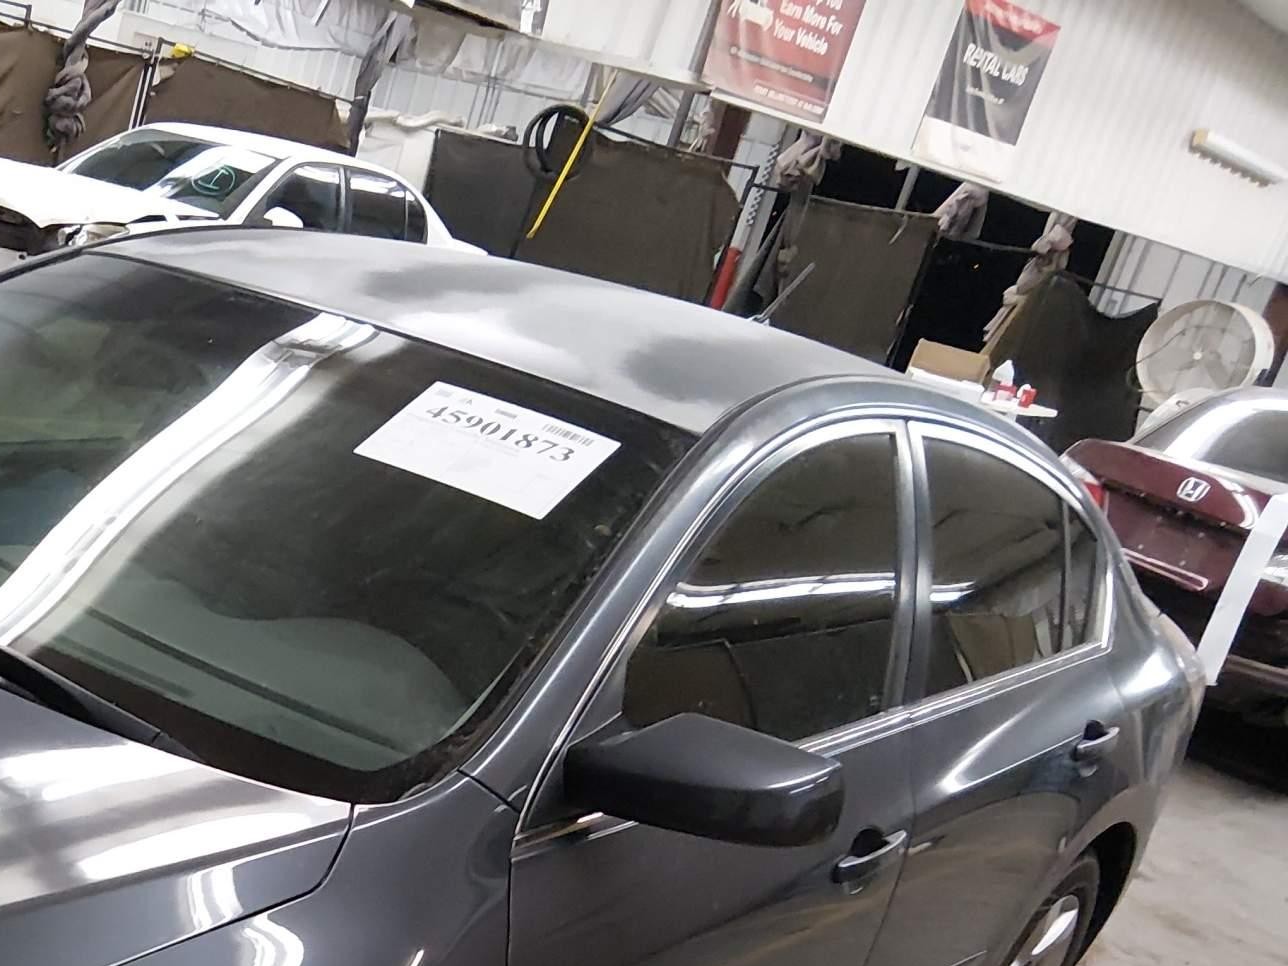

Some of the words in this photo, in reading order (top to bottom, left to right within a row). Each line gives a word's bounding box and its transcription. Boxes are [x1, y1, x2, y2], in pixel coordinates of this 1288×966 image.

[773, 18, 796, 42] Your
[795, 27, 829, 56] Vehicle
[802, 4, 828, 30] More
[826, 15, 844, 36] For
[425, 405, 575, 462] 45901873
